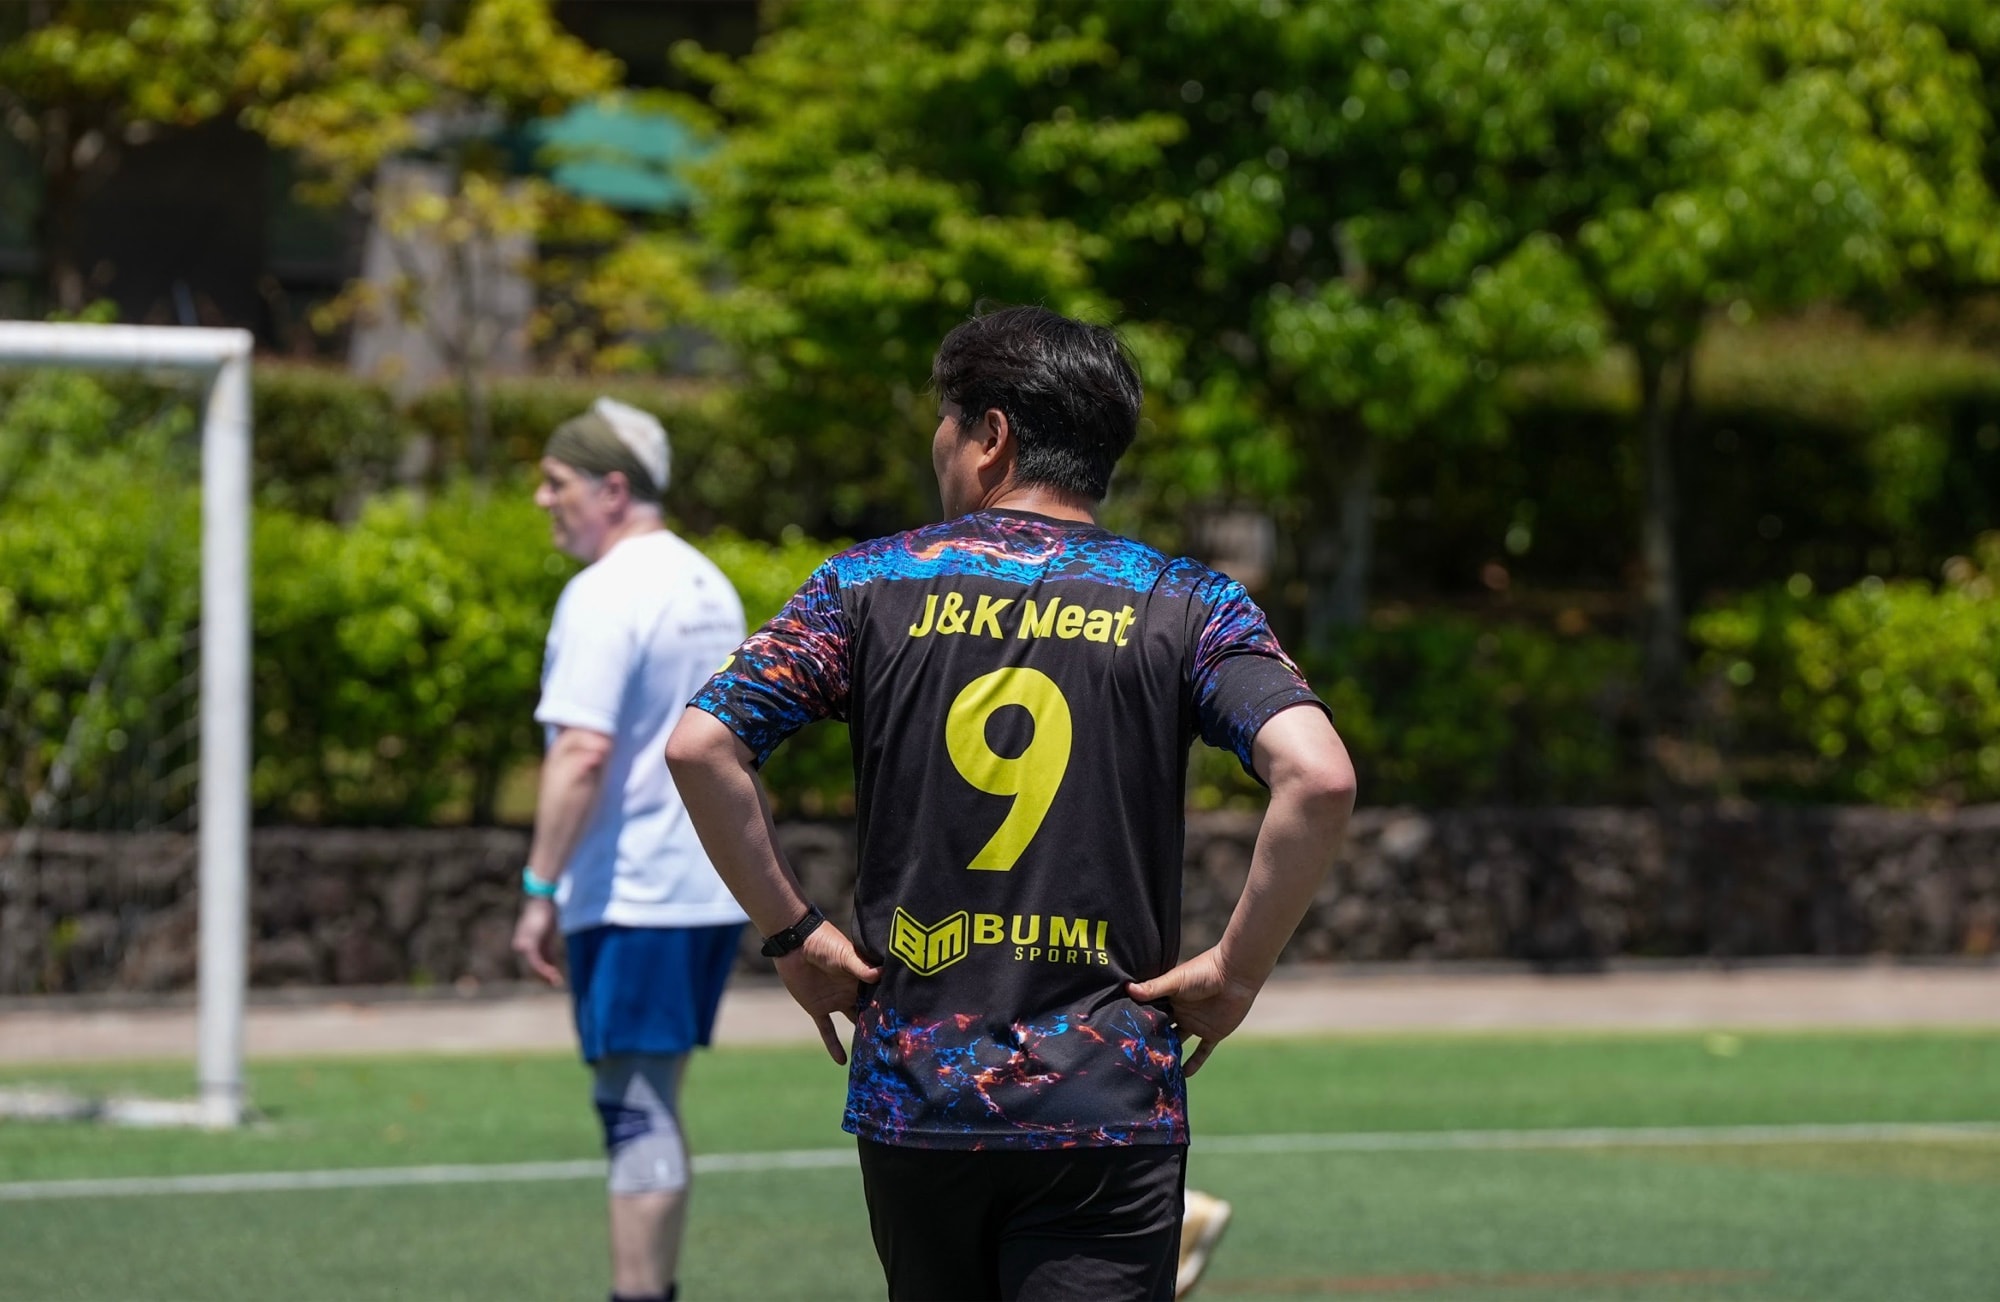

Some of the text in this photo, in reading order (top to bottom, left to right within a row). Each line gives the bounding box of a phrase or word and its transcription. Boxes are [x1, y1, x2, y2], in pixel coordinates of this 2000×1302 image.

[909, 592, 1137, 646] J&K Meat
[945, 667, 1073, 872] 9
[973, 913, 1109, 950] BUMI
[1014, 946, 1109, 966] SPORTS
